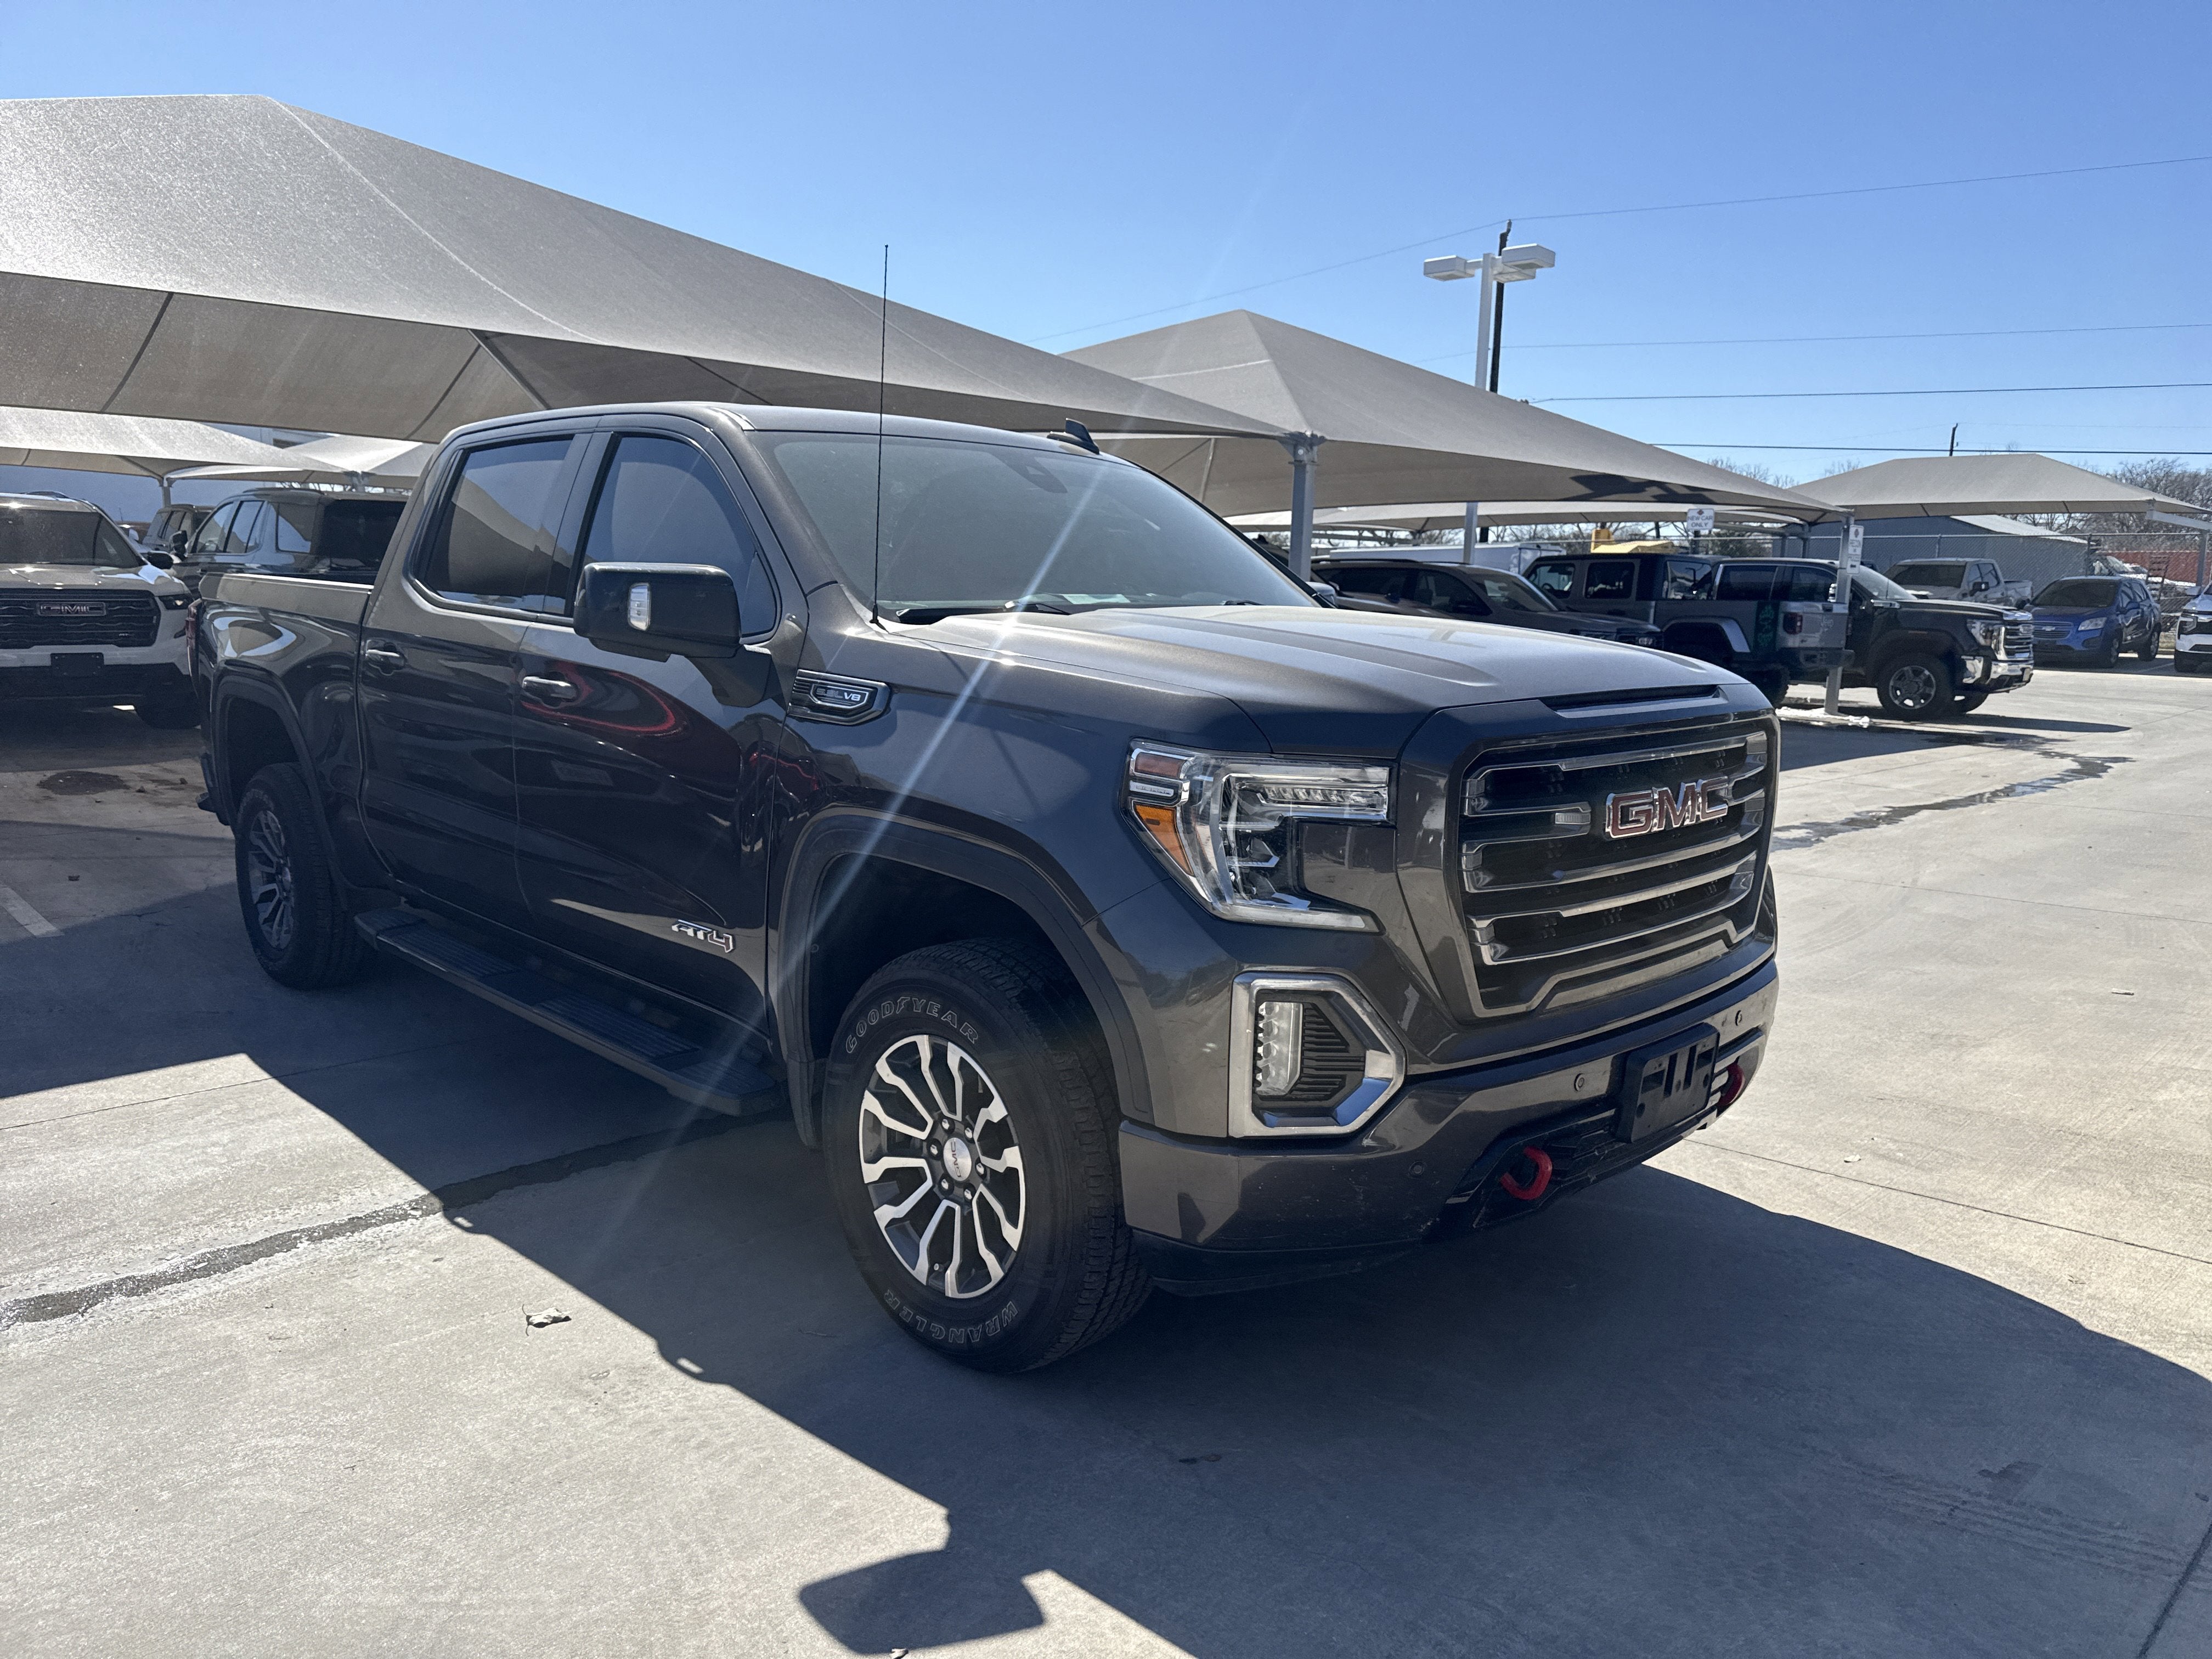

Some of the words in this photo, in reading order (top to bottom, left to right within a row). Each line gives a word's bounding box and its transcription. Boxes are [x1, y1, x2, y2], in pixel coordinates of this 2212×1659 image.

[40, 605, 104, 614] GMC
[844, 692, 861, 701] V8
[1606, 776, 1728, 838] GMC
[672, 919, 734, 953] AT4
[845, 996, 979, 1054] GOODYEAR
[951, 1141, 962, 1177] GMC
[883, 1289, 1019, 1344] WRANGLER
